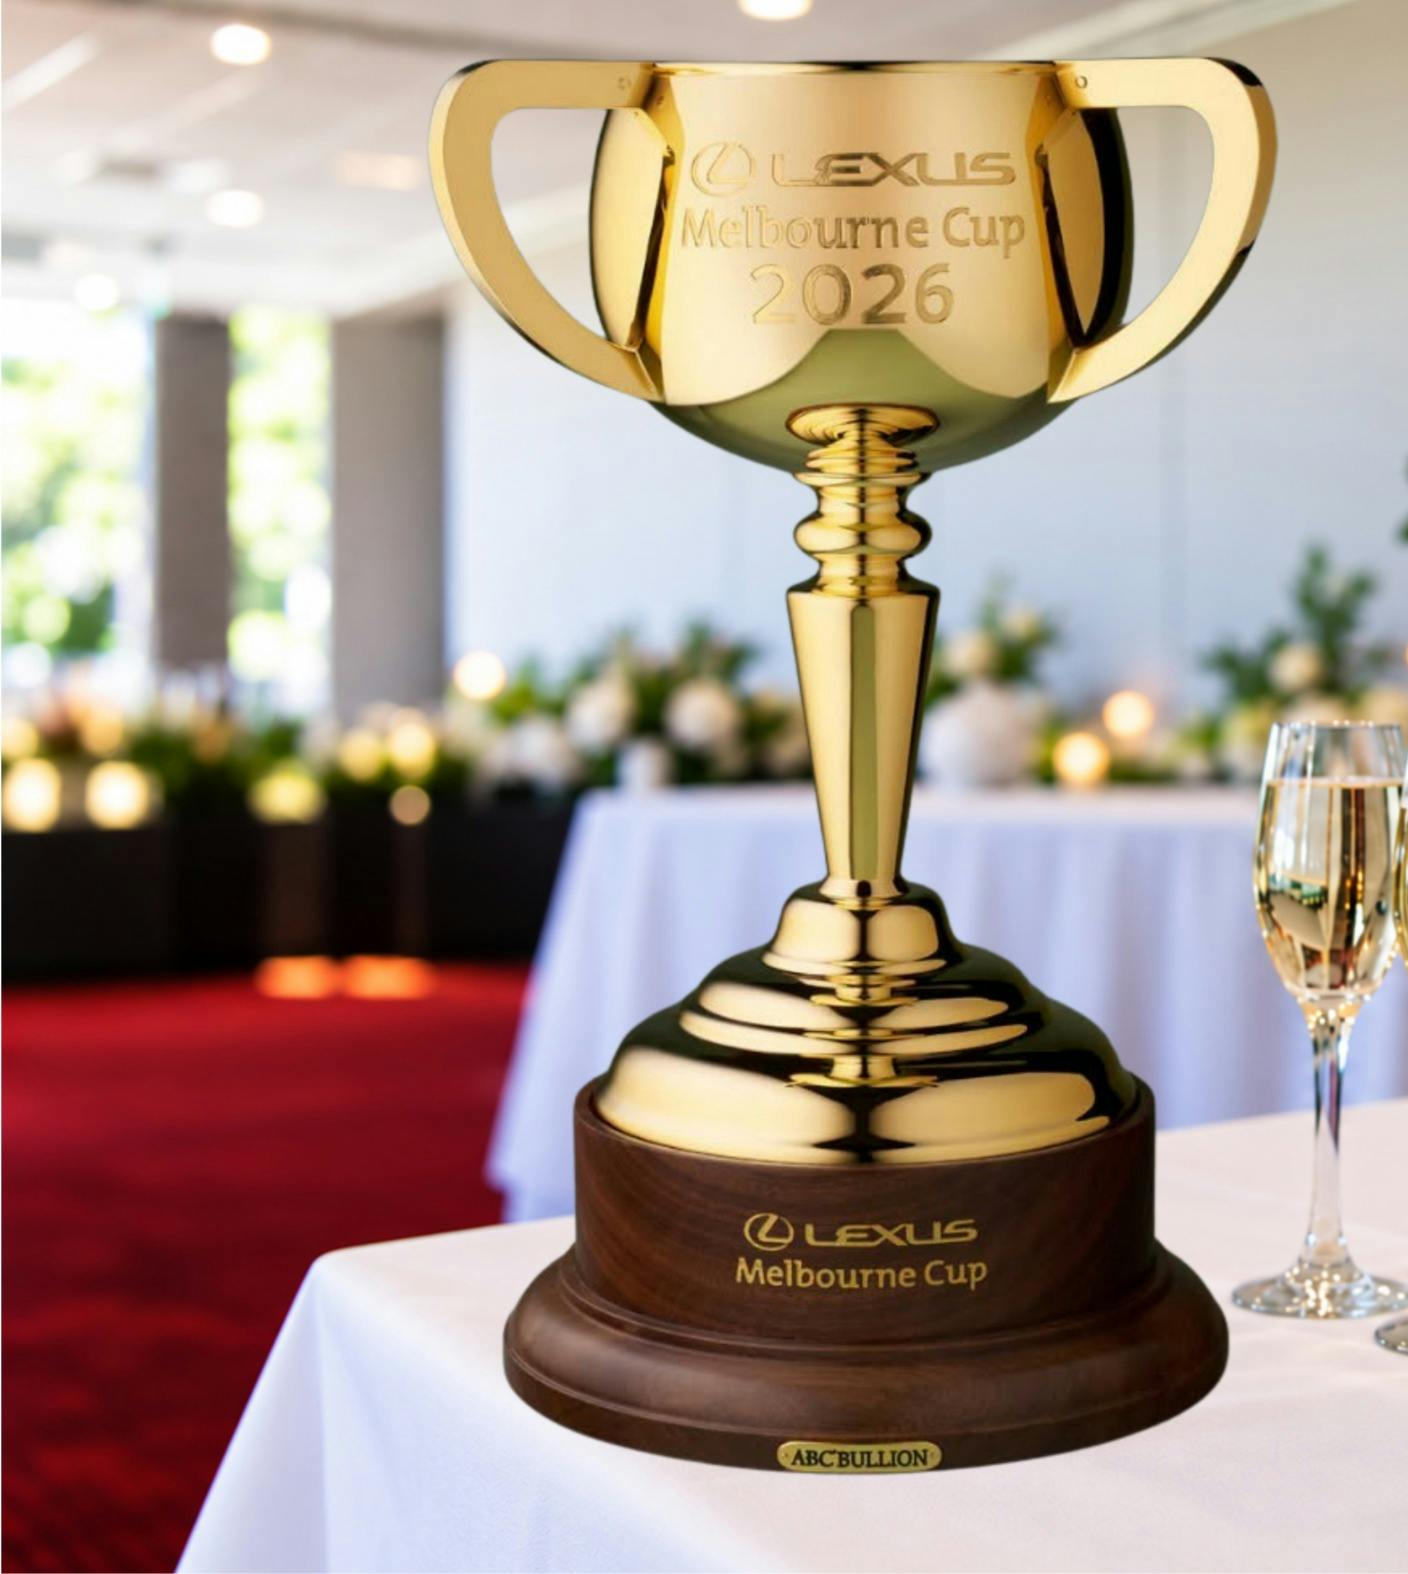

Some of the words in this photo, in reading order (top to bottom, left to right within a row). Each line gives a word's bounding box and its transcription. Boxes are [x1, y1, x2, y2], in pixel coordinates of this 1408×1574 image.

[770, 152, 1017, 187] LEXUS
[680, 205, 929, 250] Melbourne
[941, 206, 1026, 259] Cup
[750, 263, 954, 326] 2026
[804, 1219, 978, 1247] LEXUS
[736, 1257, 917, 1288] Melbourne
[924, 1260, 988, 1290] Cup
